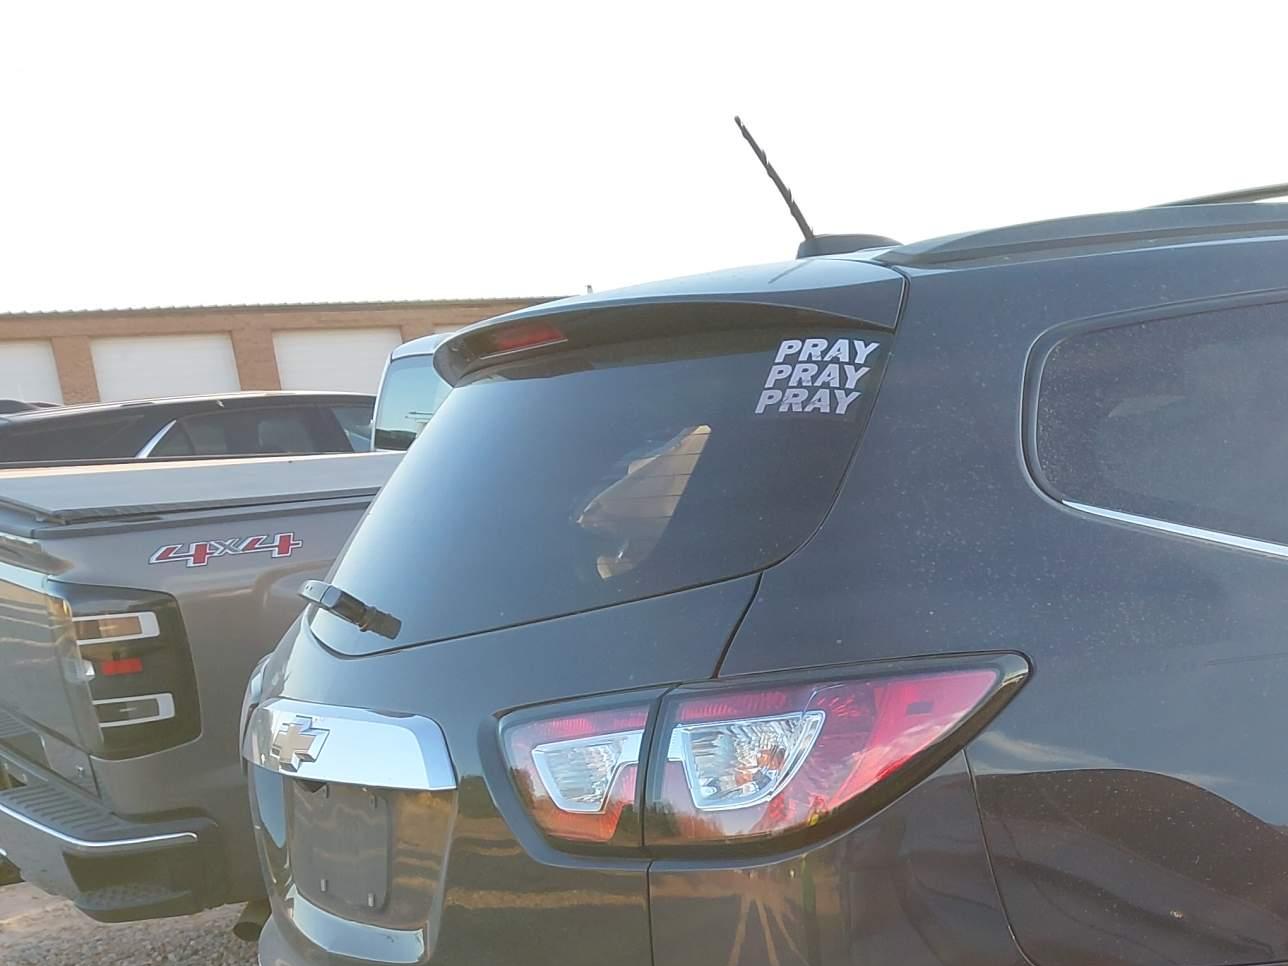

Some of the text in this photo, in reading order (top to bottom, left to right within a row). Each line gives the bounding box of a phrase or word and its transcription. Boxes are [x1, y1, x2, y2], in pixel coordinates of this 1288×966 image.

[774, 338, 880, 364] PRAY
[764, 363, 871, 389] PRAY
[754, 388, 861, 415] PRAY
